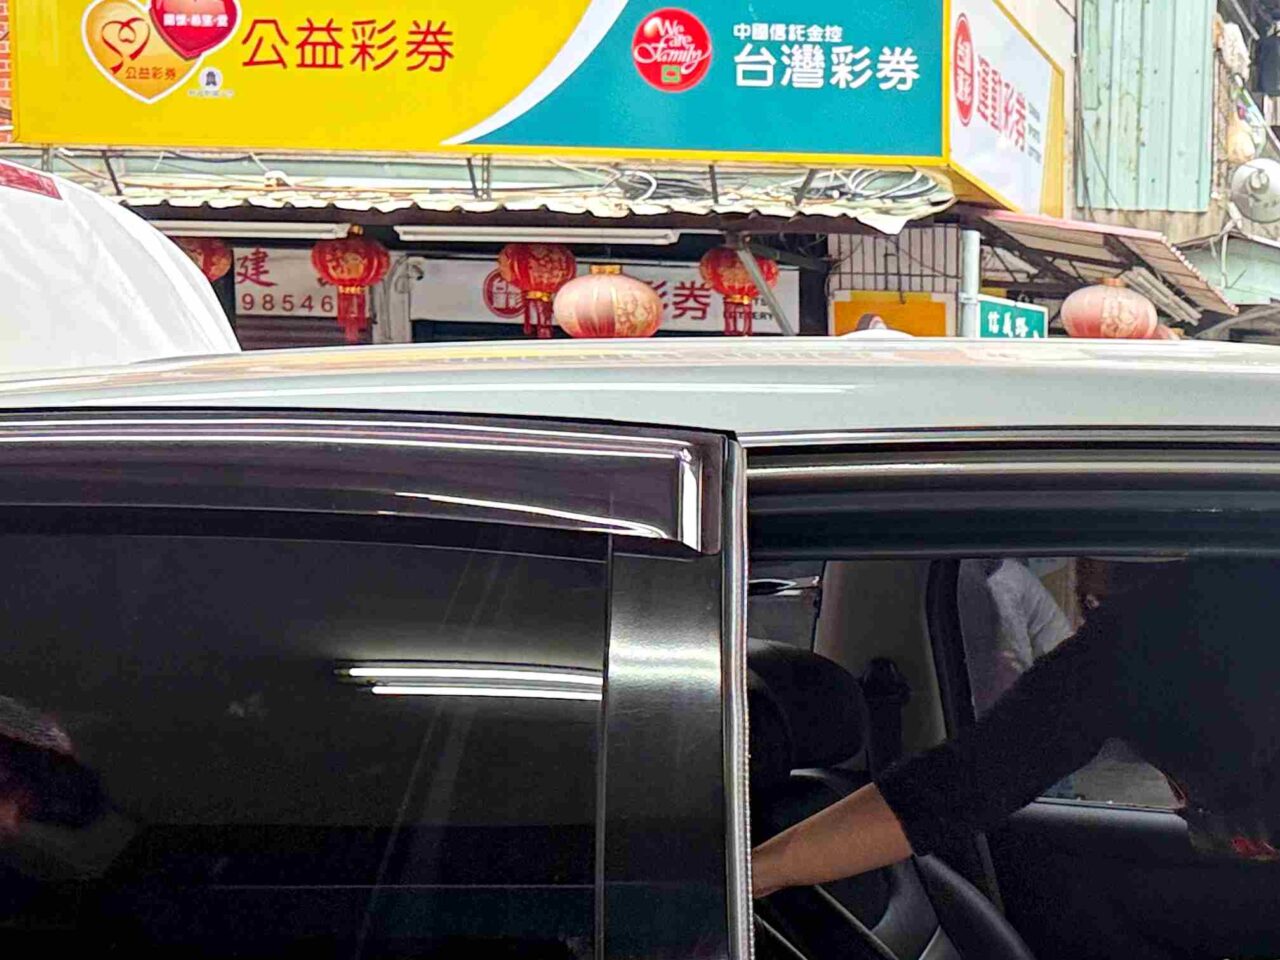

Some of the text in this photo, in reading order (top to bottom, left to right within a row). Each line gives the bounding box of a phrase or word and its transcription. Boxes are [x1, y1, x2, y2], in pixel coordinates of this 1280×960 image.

[644, 17, 685, 37] We
[733, 23, 843, 43] 中國信託金控
[241, 17, 455, 73] 公益彩券
[733, 43, 920, 91] 台灣彩券
[242, 293, 334, 312] 98546
